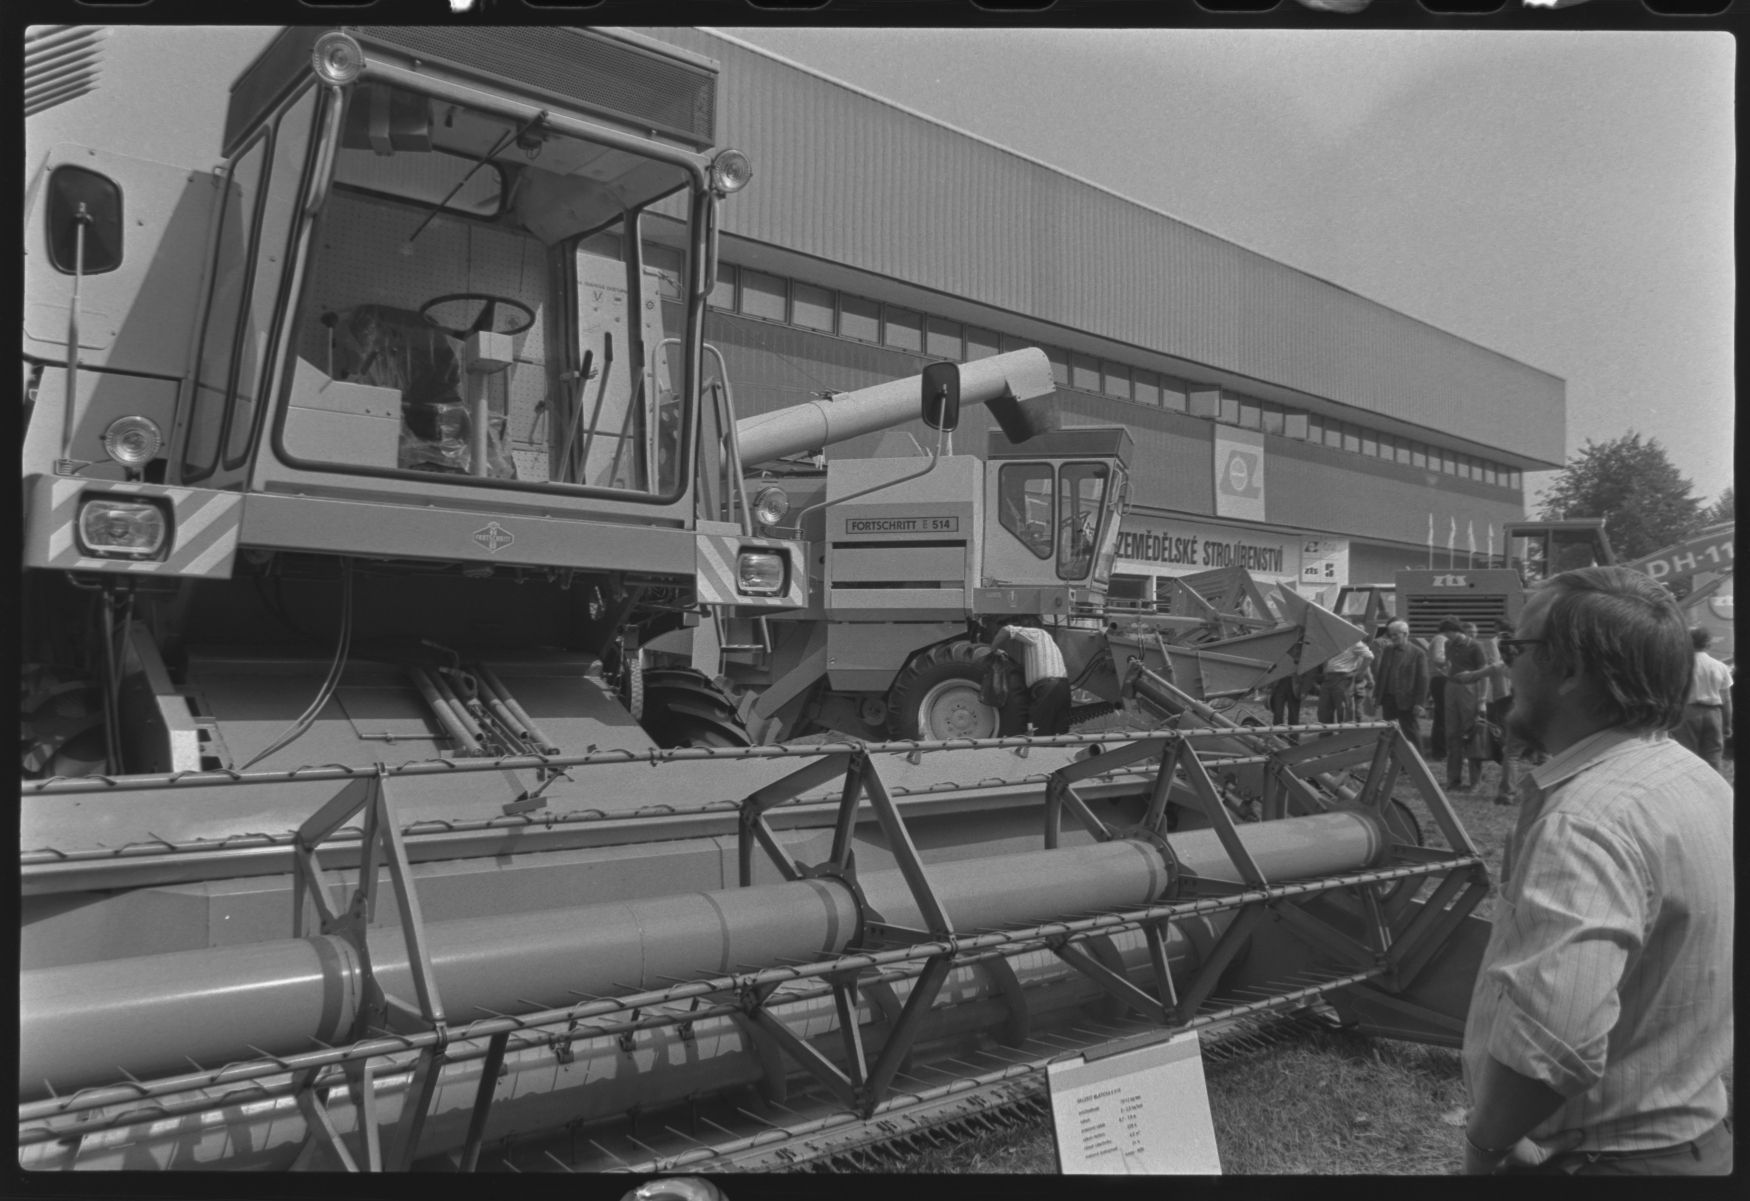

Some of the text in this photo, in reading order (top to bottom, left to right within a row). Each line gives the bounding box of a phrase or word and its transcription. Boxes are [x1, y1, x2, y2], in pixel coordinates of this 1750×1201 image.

[852, 520, 950, 531] FORTSCHRITT E 514
[1116, 530, 1198, 565] ZEMĚDĚLSKÉ
